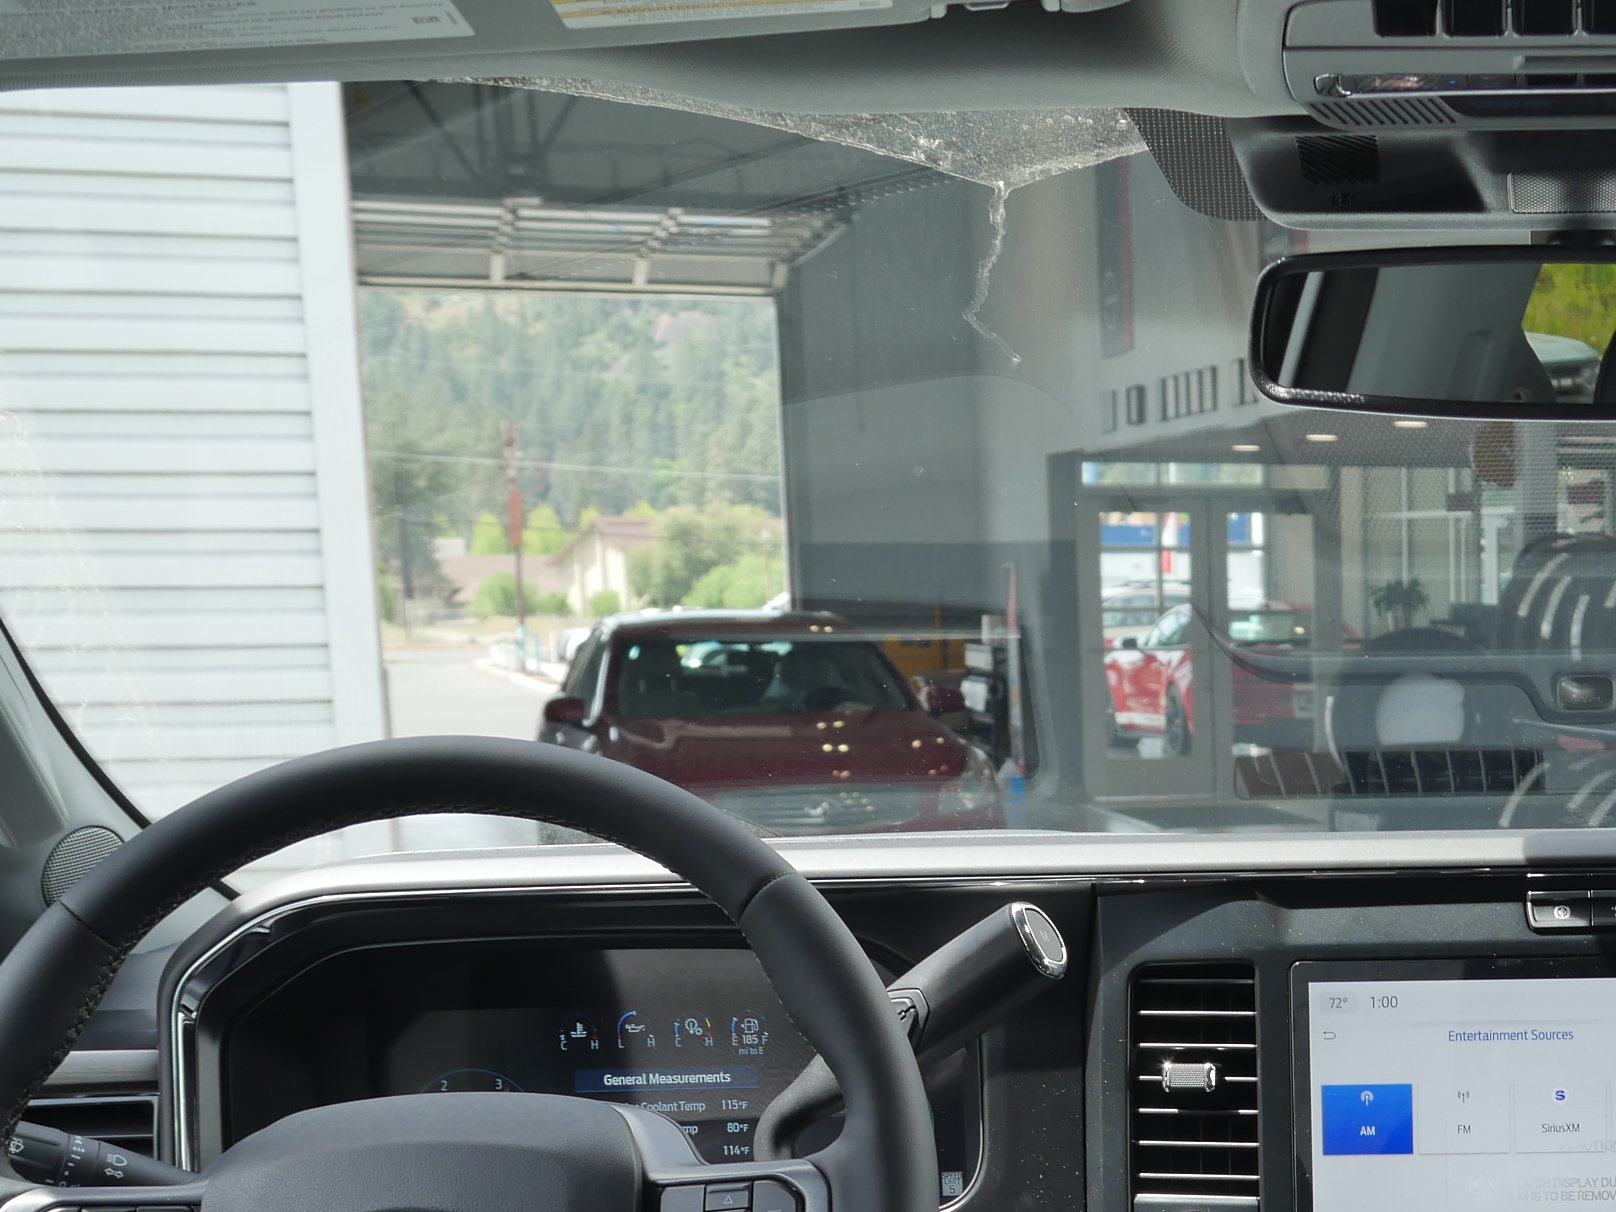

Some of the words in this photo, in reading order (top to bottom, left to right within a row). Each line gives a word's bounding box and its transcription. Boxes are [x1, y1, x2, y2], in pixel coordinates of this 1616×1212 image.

[1329, 997, 1348, 1009] 72°
[1370, 996, 1398, 1009] 1:00
[742, 1035, 758, 1044] 185
[1448, 1030, 1528, 1042] Entertainment
[1531, 1029, 1574, 1041] Sources
[739, 1047, 748, 1055] mi
[749, 1047, 758, 1055] to
[758, 1046, 764, 1055] E
[495, 1079, 503, 1089] 3
[604, 1074, 646, 1086] General
[649, 1072, 731, 1084] Measurements
[441, 1080, 448, 1091] 2
[679, 1101, 705, 1112] Temp
[1360, 1125, 1376, 1136] AM
[1457, 1125, 1471, 1134] FM
[1541, 1123, 1580, 1133] SiriusXM
[1553, 1177, 1599, 1188] DISPLAY
[1530, 1190, 1541, 1201] IS
[1543, 1190, 1558, 1201] TO
[1561, 1190, 1575, 1201] BE
